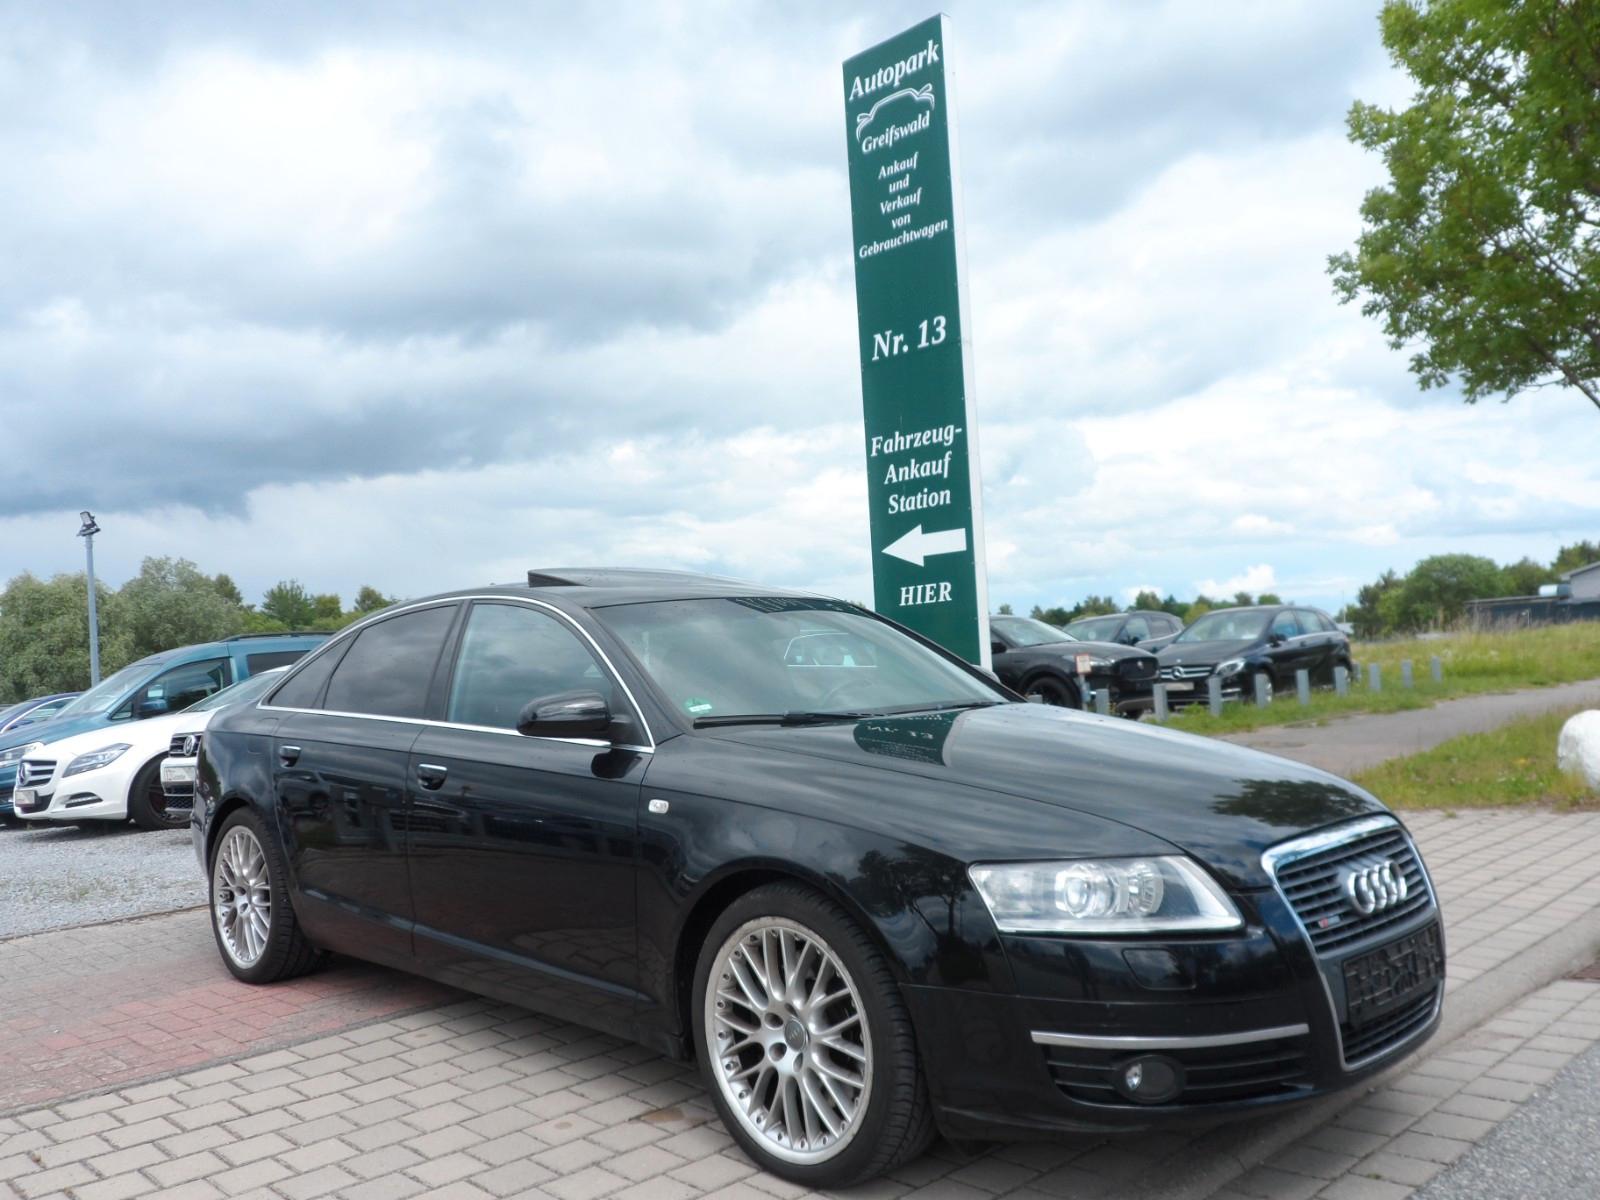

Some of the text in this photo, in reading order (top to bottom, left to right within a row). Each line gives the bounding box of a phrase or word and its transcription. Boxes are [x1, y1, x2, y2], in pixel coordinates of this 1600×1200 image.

[849, 40, 939, 101] Autopark
[862, 110, 930, 153] Greifswald
[878, 152, 919, 179] Ankauf
[889, 174, 909, 193] und
[880, 187, 922, 215] Verkauf
[891, 213, 911, 229] von
[859, 219, 948, 259] Gebrauchtwagen
[872, 315, 946, 361] Nr. 13
[871, 424, 962, 457] Fahrzeug-
[884, 451, 951, 484] Ankauf
[888, 488, 950, 514] Station
[899, 581, 953, 606] HIER
